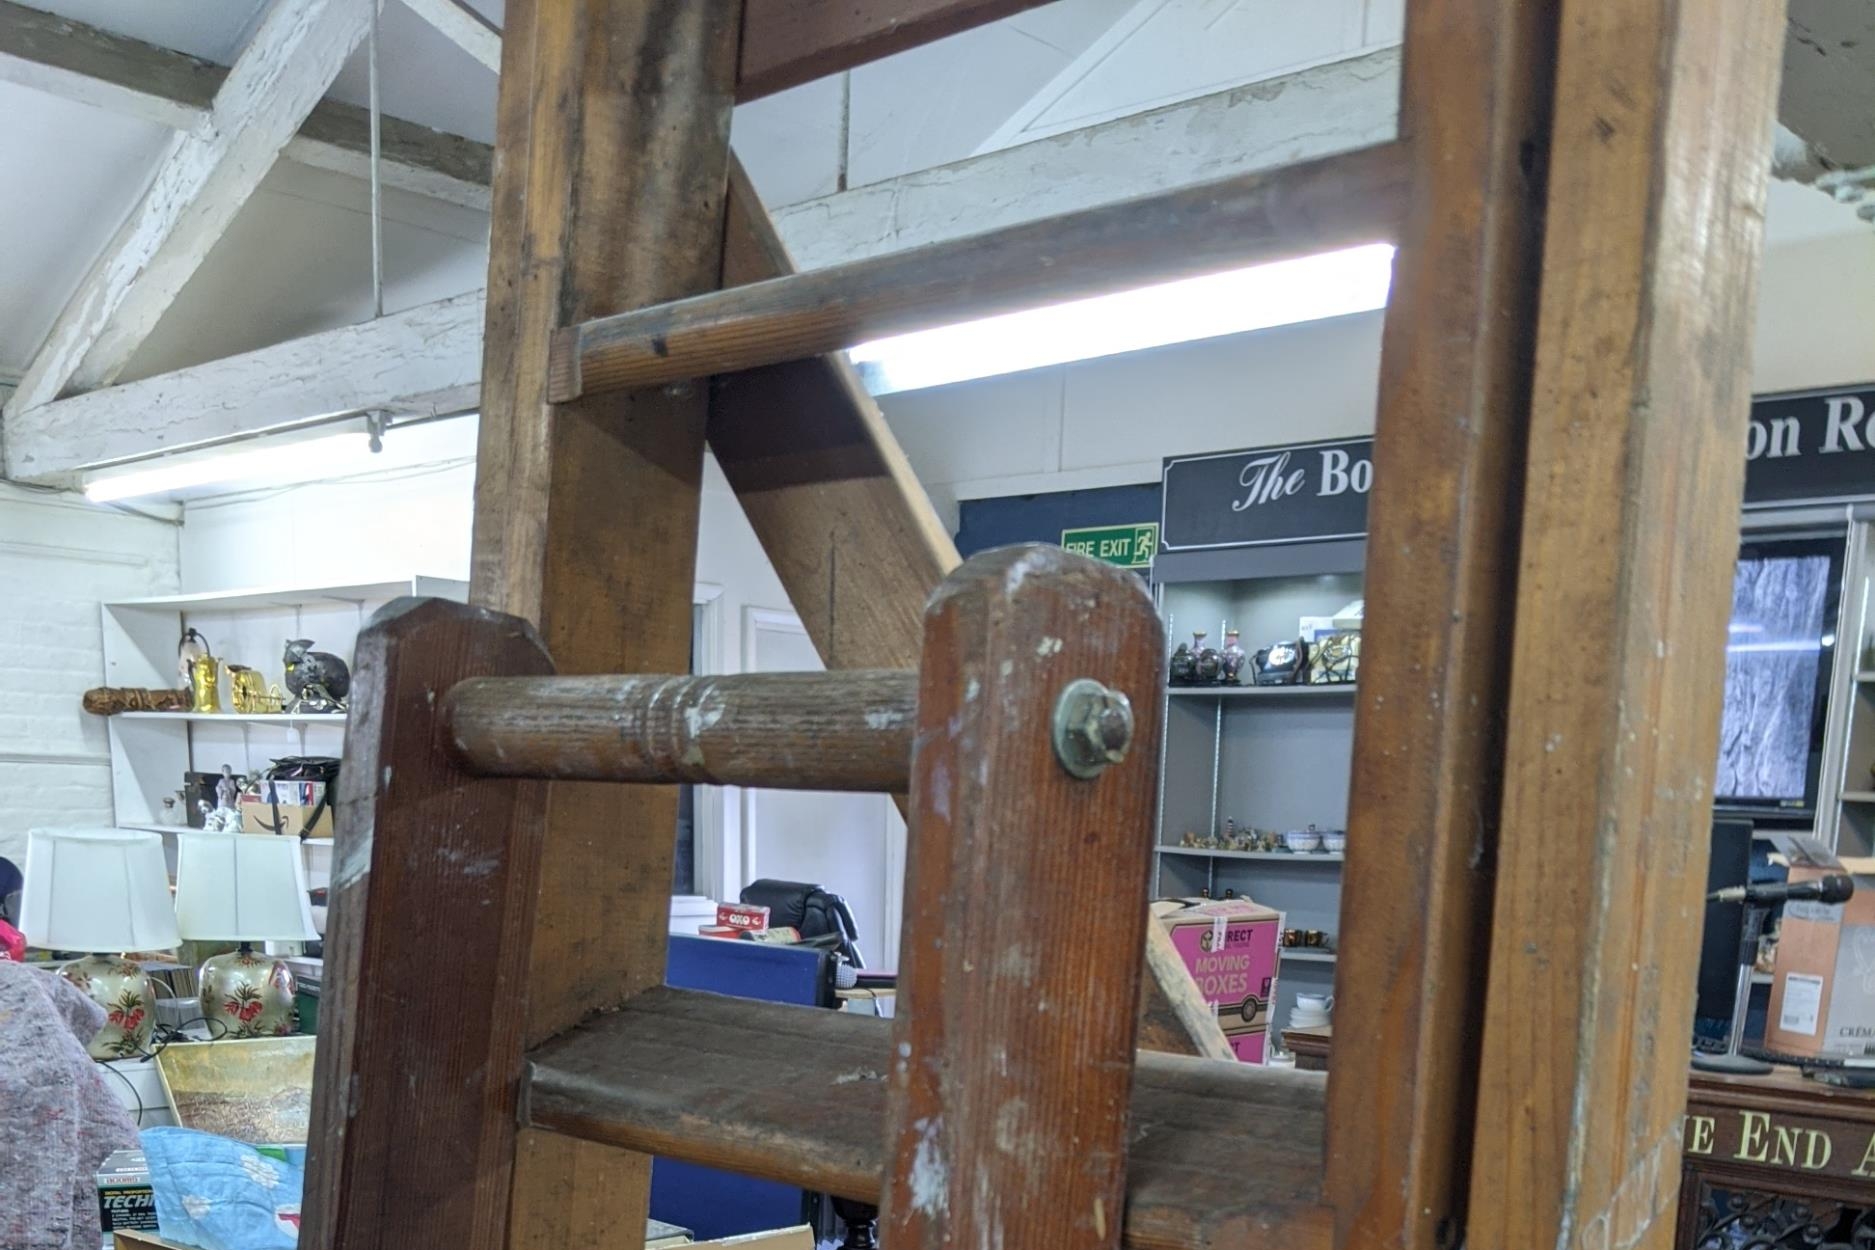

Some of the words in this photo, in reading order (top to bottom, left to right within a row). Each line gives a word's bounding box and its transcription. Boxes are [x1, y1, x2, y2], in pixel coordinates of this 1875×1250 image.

[1231, 451, 1306, 512] The
[1316, 448, 1373, 496] Bo
[1745, 416, 1802, 460] on
[1100, 538, 1132, 557] EXIT
[729, 913, 751, 926] OXO
[1195, 954, 1250, 975] MOVING
[1733, 1109, 1832, 1170] END
